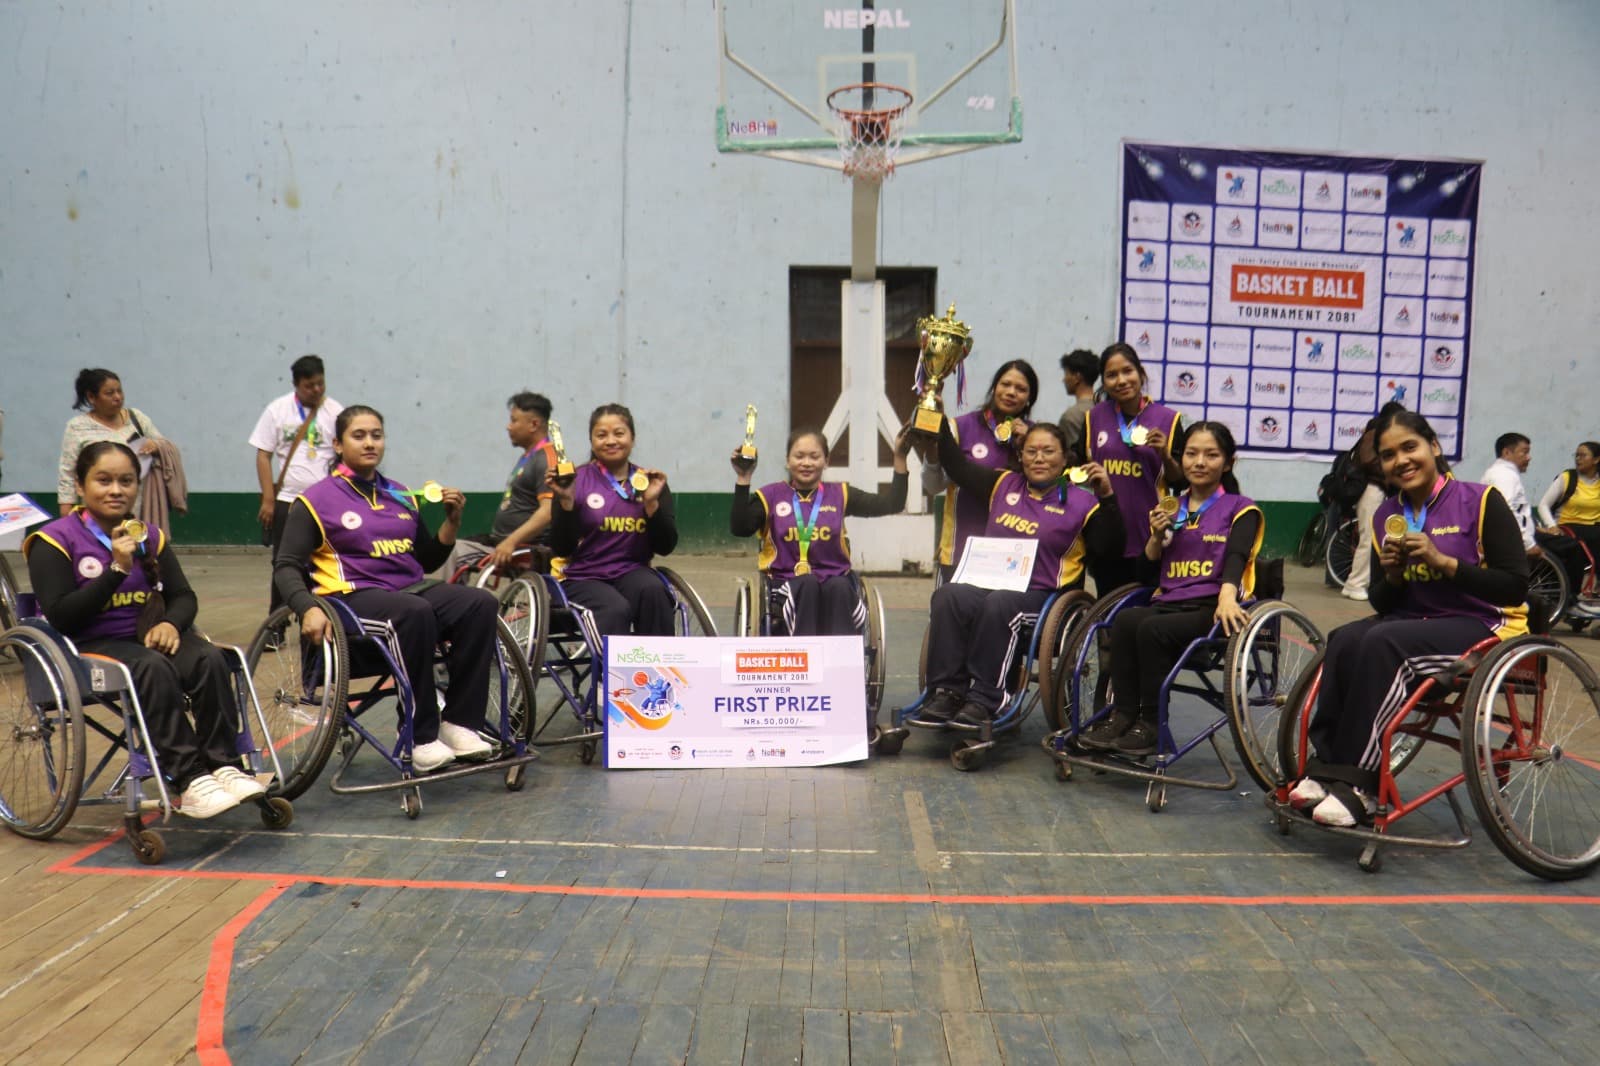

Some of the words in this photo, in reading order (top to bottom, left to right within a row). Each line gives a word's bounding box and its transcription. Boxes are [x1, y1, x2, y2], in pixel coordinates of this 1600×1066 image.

[824, 9, 910, 29] NEPAL
[1236, 272, 1308, 297] BASKET
[1312, 277, 1358, 300] BALL
[1238, 306, 1321, 321] TOURNAMENT
[1327, 311, 1356, 323] 2081
[600, 516, 647, 533] JWSC
[995, 512, 1039, 535] JWSC
[1167, 560, 1214, 578] JWSC
[739, 656, 777, 668] BASKET
[779, 656, 805, 668] BALL
[737, 673, 787, 681] TOURNAMENT
[754, 686, 791, 694] WINNER
[714, 696, 770, 713] FIRST
[775, 695, 832, 712] PRIZE
